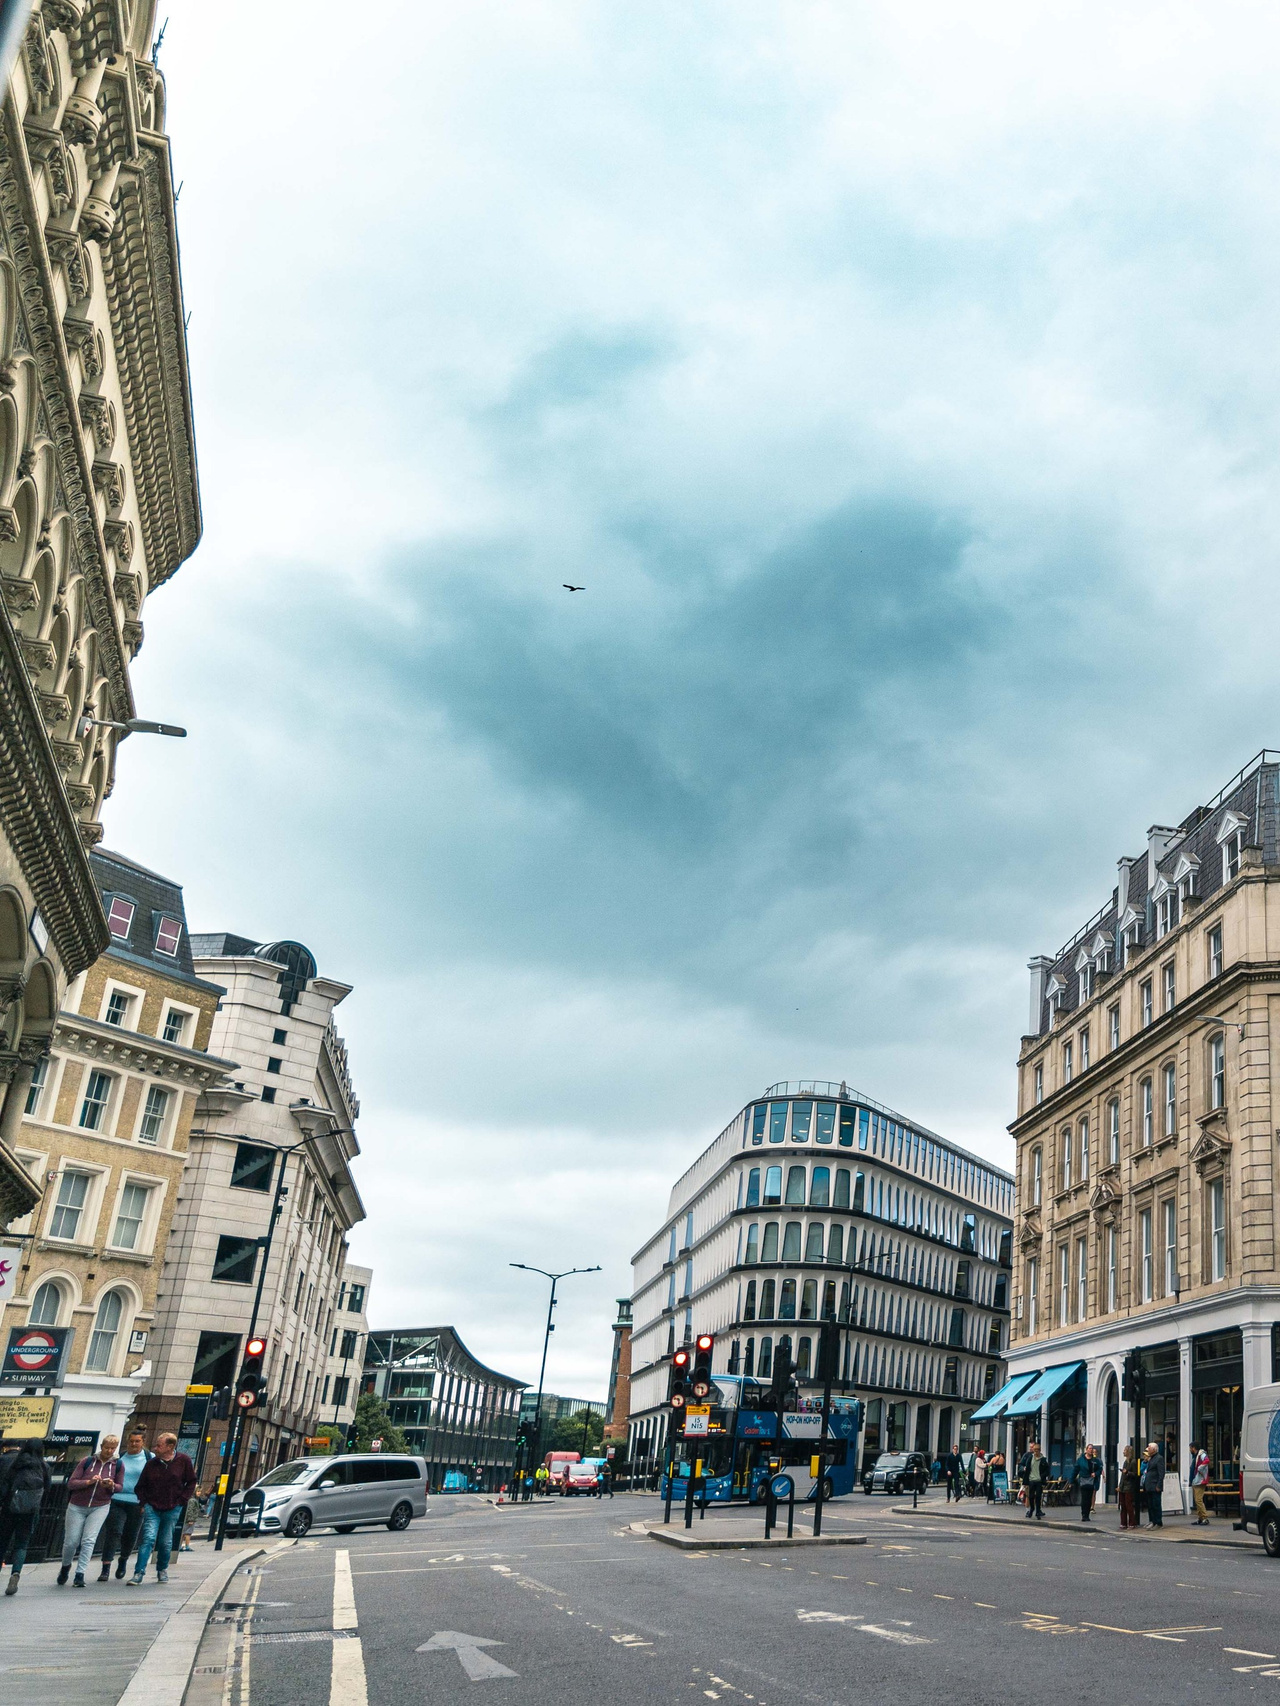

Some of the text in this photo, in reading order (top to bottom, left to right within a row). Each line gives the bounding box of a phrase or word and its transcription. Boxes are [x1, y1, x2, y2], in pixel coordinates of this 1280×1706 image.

[786, 1415, 822, 1424] HOP-ON HOP-OFF
[75, 1436, 92, 1444] gyoza
